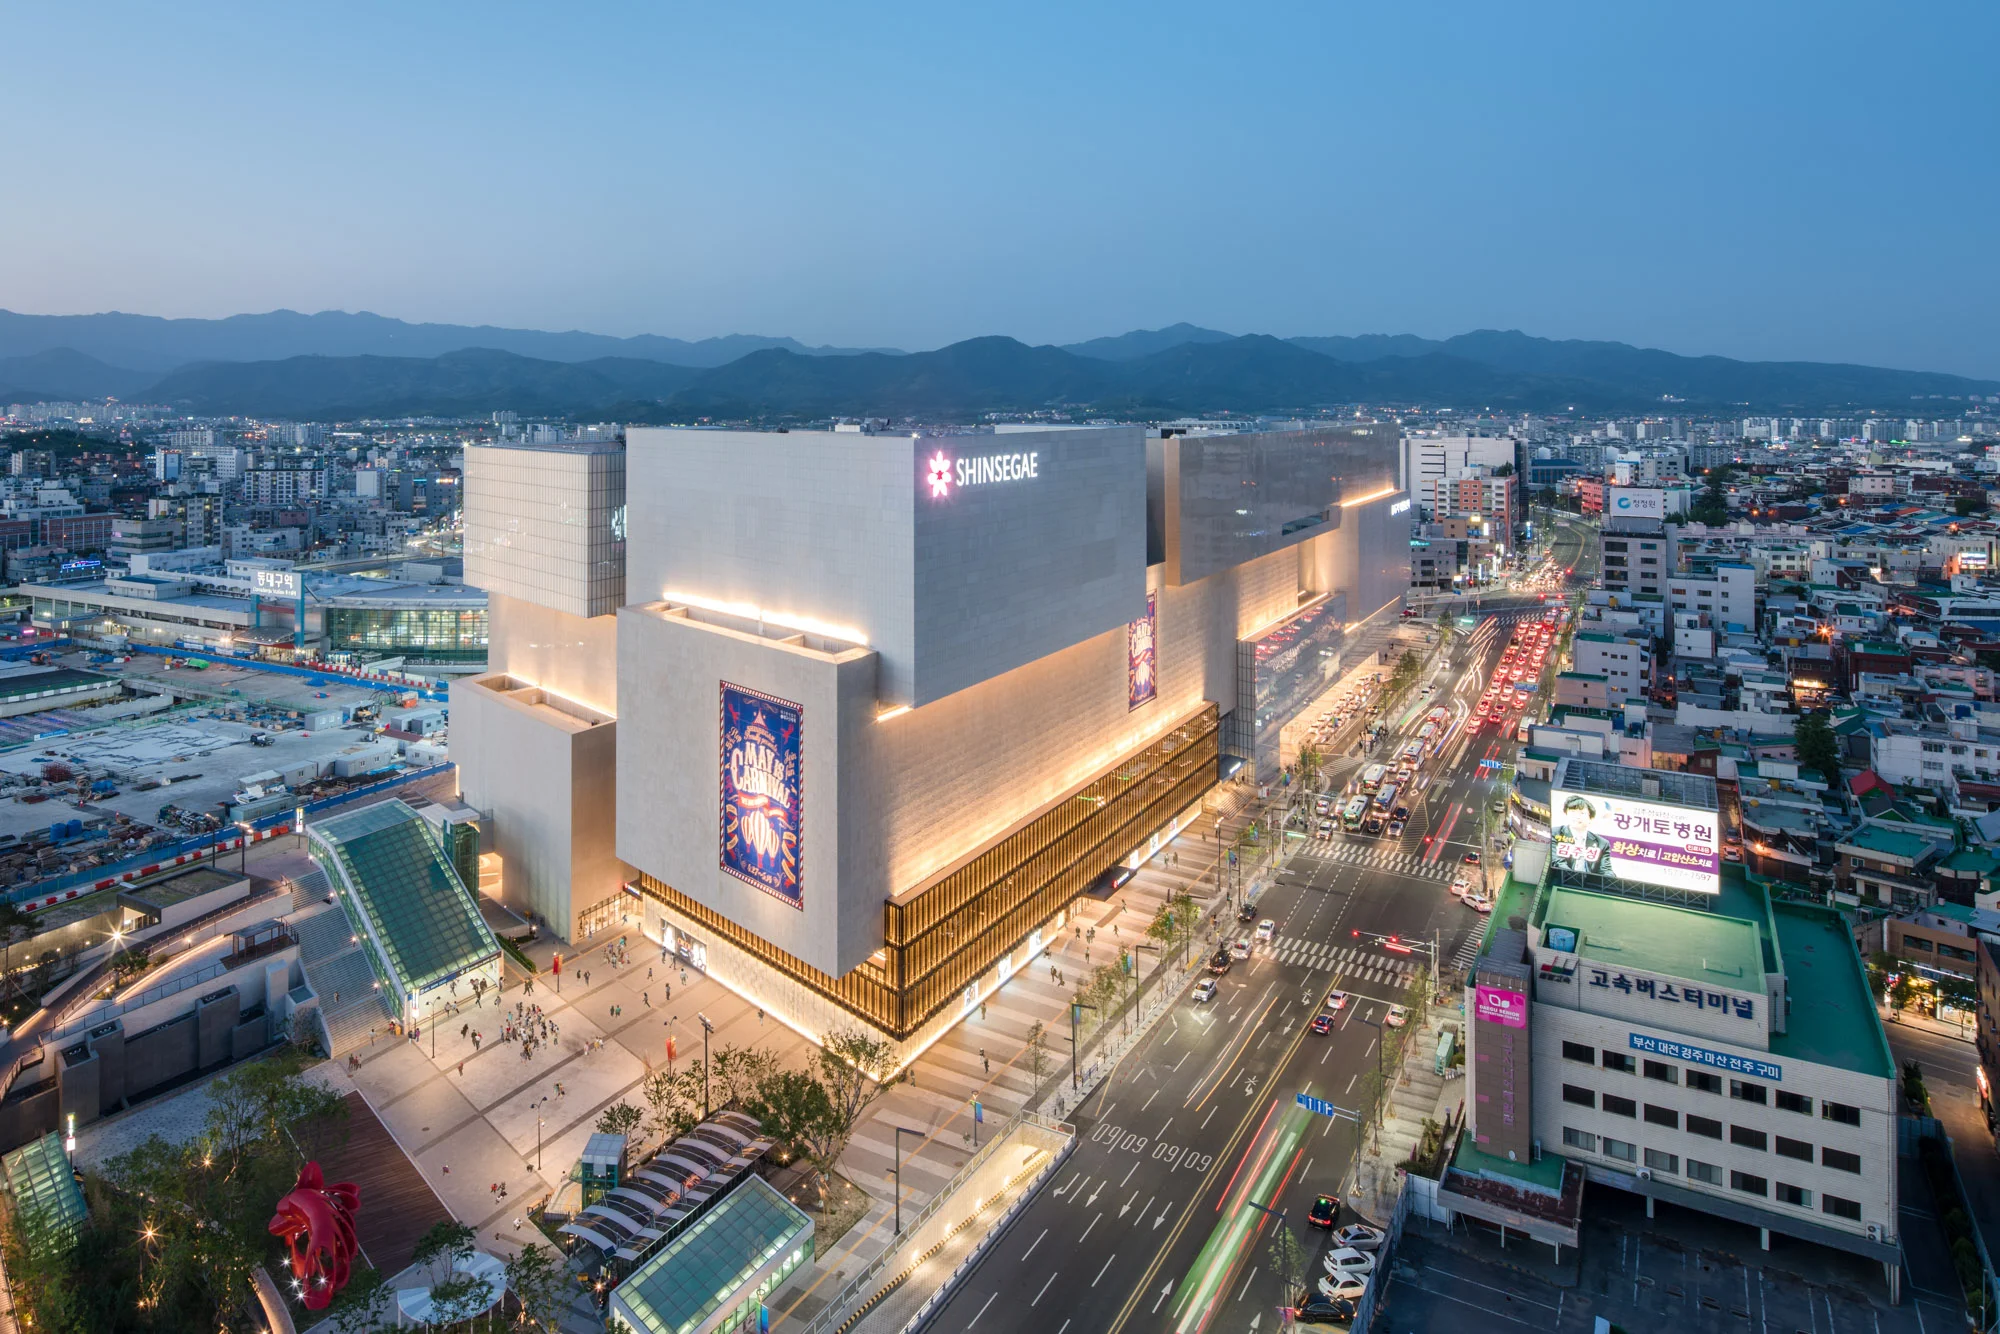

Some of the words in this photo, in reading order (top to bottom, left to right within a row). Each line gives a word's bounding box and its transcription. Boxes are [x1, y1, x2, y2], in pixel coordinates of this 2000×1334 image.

[956, 452, 1038, 487] SHINSEGAE
[257, 571, 293, 589] 동대구역
[745, 741, 775, 773] MAY
[730, 748, 791, 809] CARNIVAL
[1613, 813, 1712, 843] 광개토병원
[1557, 844, 1599, 860] 김주성
[1612, 841, 1656, 859] 화상치료
[1661, 851, 1713, 868] 고압산소치료
[1479, 1004, 1498, 1013] DAEGU
[1499, 1009, 1520, 1017] SENIOR
[1589, 970, 1753, 1020] 고속버스터미널
[1633, 1036, 1655, 1051] 부산
[1658, 1042, 1679, 1056] 대전
[1681, 1047, 1702, 1061] 경주
[1705, 1053, 1727, 1067] 마산
[1730, 1058, 1754, 1072] 전주
[1757, 1063, 1779, 1079] 구미
